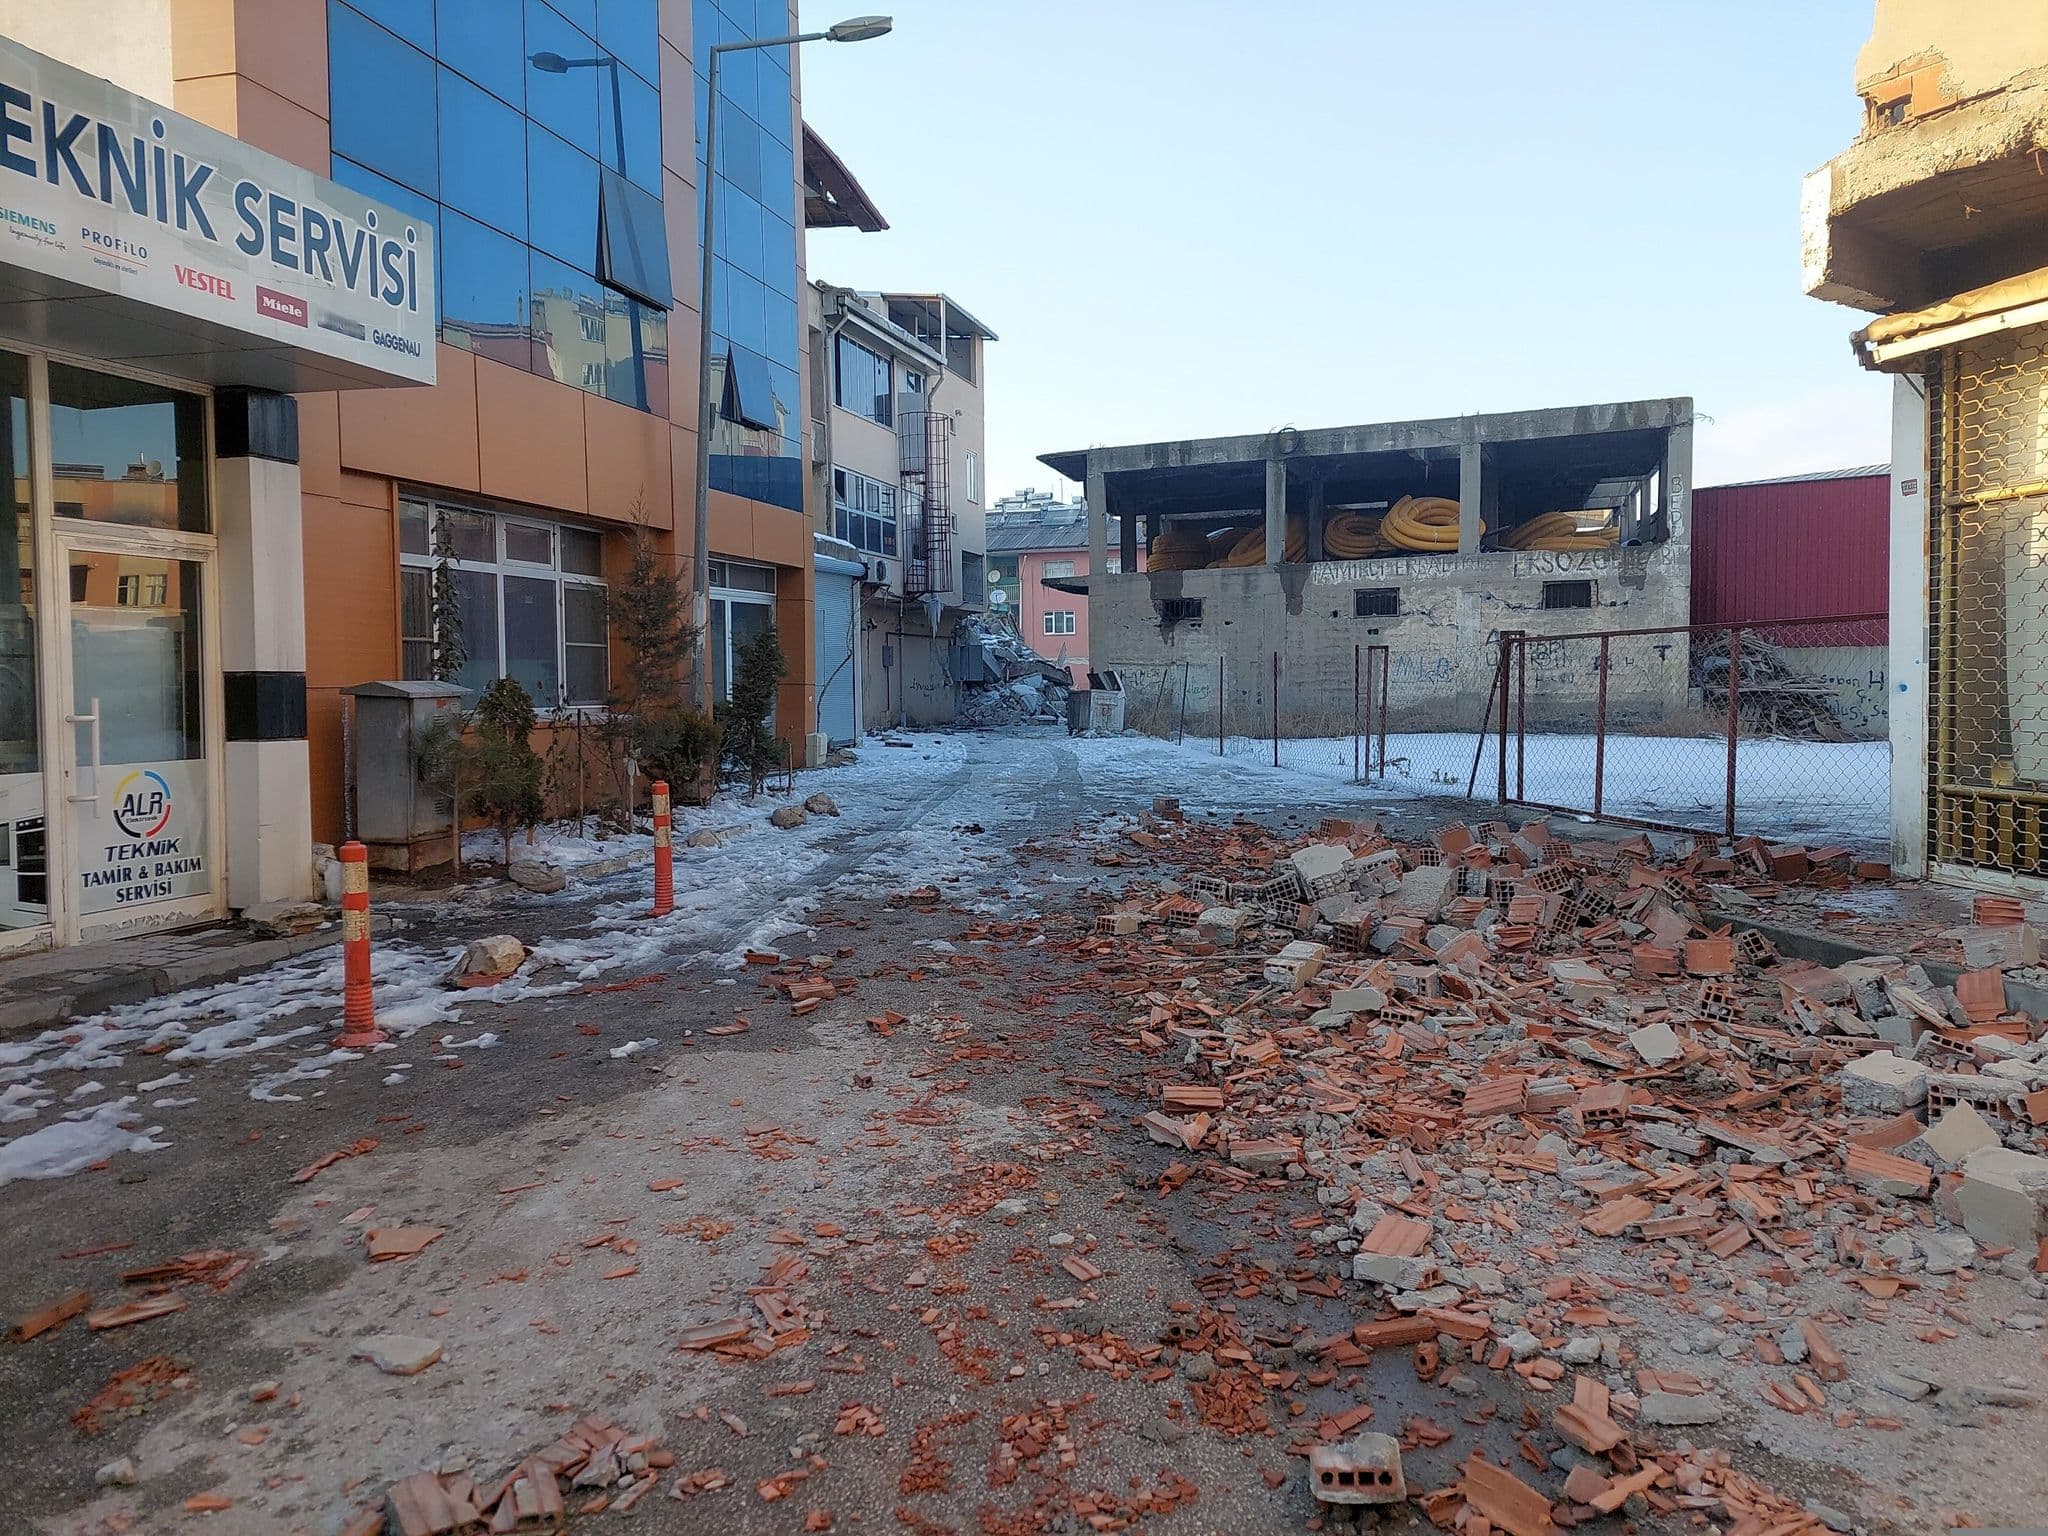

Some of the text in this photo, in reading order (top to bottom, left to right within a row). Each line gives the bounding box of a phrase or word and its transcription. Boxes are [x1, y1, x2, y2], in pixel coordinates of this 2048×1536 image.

[0, 207, 56, 235] SIEMENS
[234, 182, 418, 312] SERVİSİ
[174, 264, 236, 300] VESTEL
[262, 296, 302, 317] Miele
[373, 329, 420, 357] GAGGENAU
[121, 792, 163, 817] ALR
[81, 857, 202, 887] TAMİR & BAKIM
[116, 877, 172, 903] SERVİSİ
